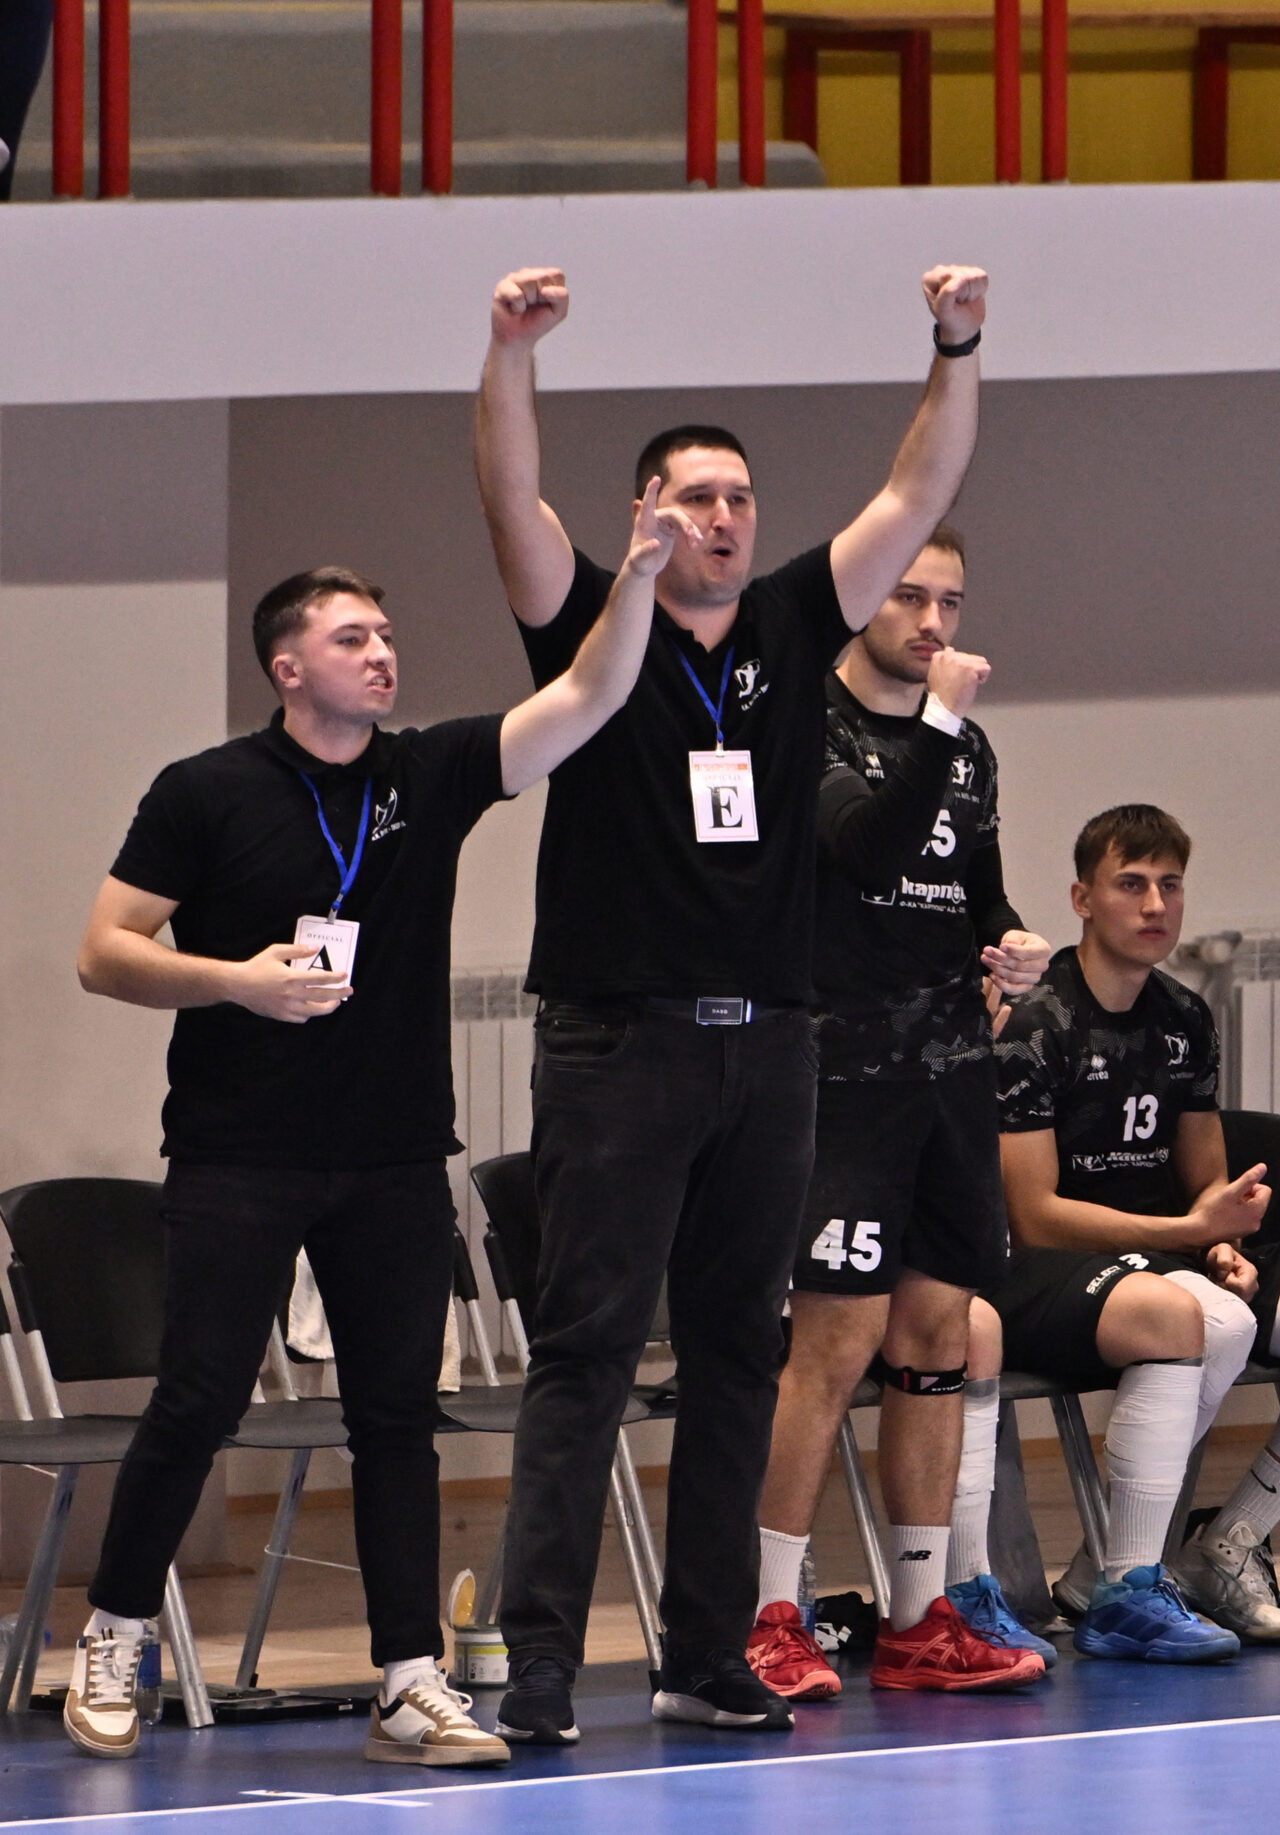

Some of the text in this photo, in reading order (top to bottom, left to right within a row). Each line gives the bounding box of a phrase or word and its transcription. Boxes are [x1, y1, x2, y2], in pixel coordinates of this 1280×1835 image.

[707, 785, 743, 829] E
[920, 808, 957, 858] 5
[307, 944, 334, 973] A
[1122, 1094, 1159, 1142] 13
[811, 1219, 883, 1272] 45
